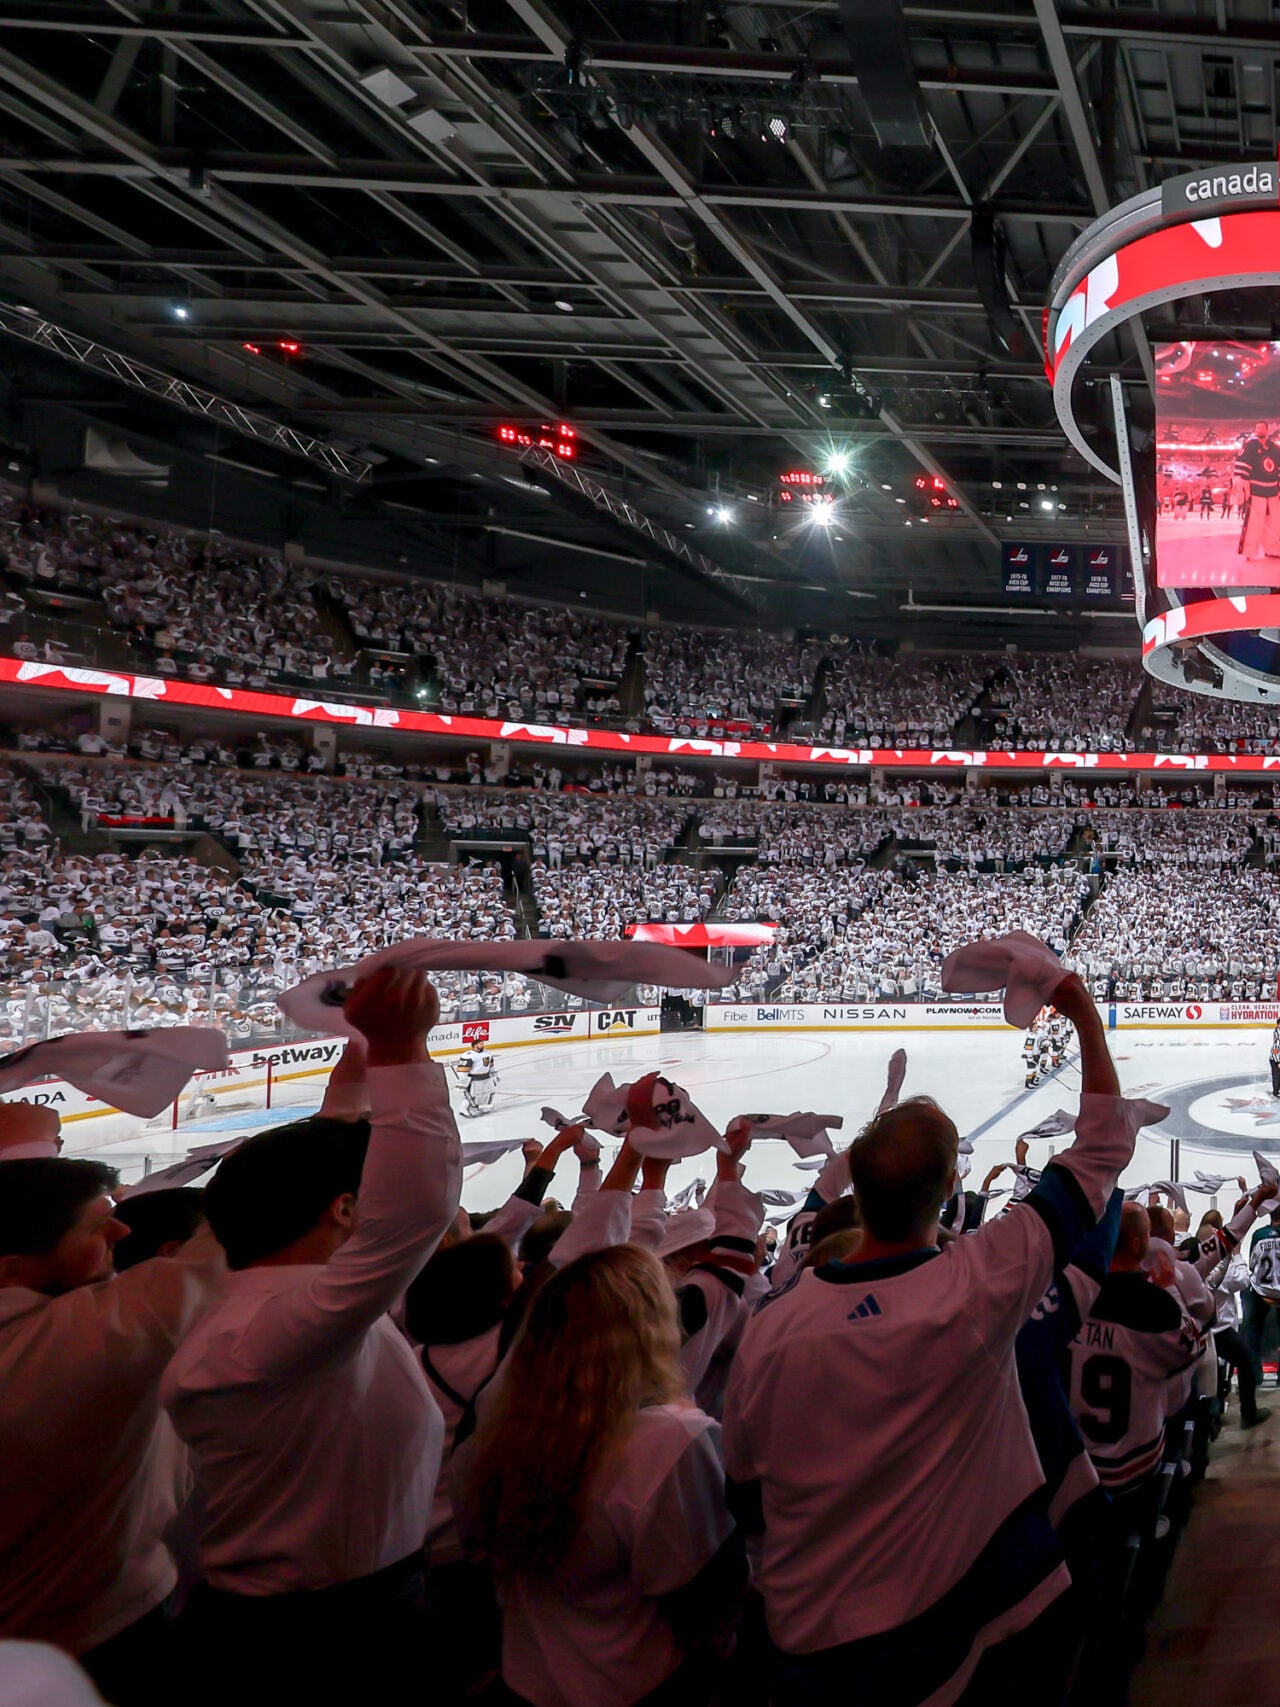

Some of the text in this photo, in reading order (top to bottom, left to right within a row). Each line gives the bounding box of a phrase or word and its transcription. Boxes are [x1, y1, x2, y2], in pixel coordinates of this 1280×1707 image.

[1184, 167, 1273, 202] canada
[598, 1010, 636, 1031] CAT
[723, 1011, 748, 1022] Fibe
[823, 1008, 907, 1020] NISSAN
[1124, 1007, 1184, 1019] SAFEWAY
[534, 1014, 576, 1029] SN
[1074, 1321, 1115, 1350] TAN
